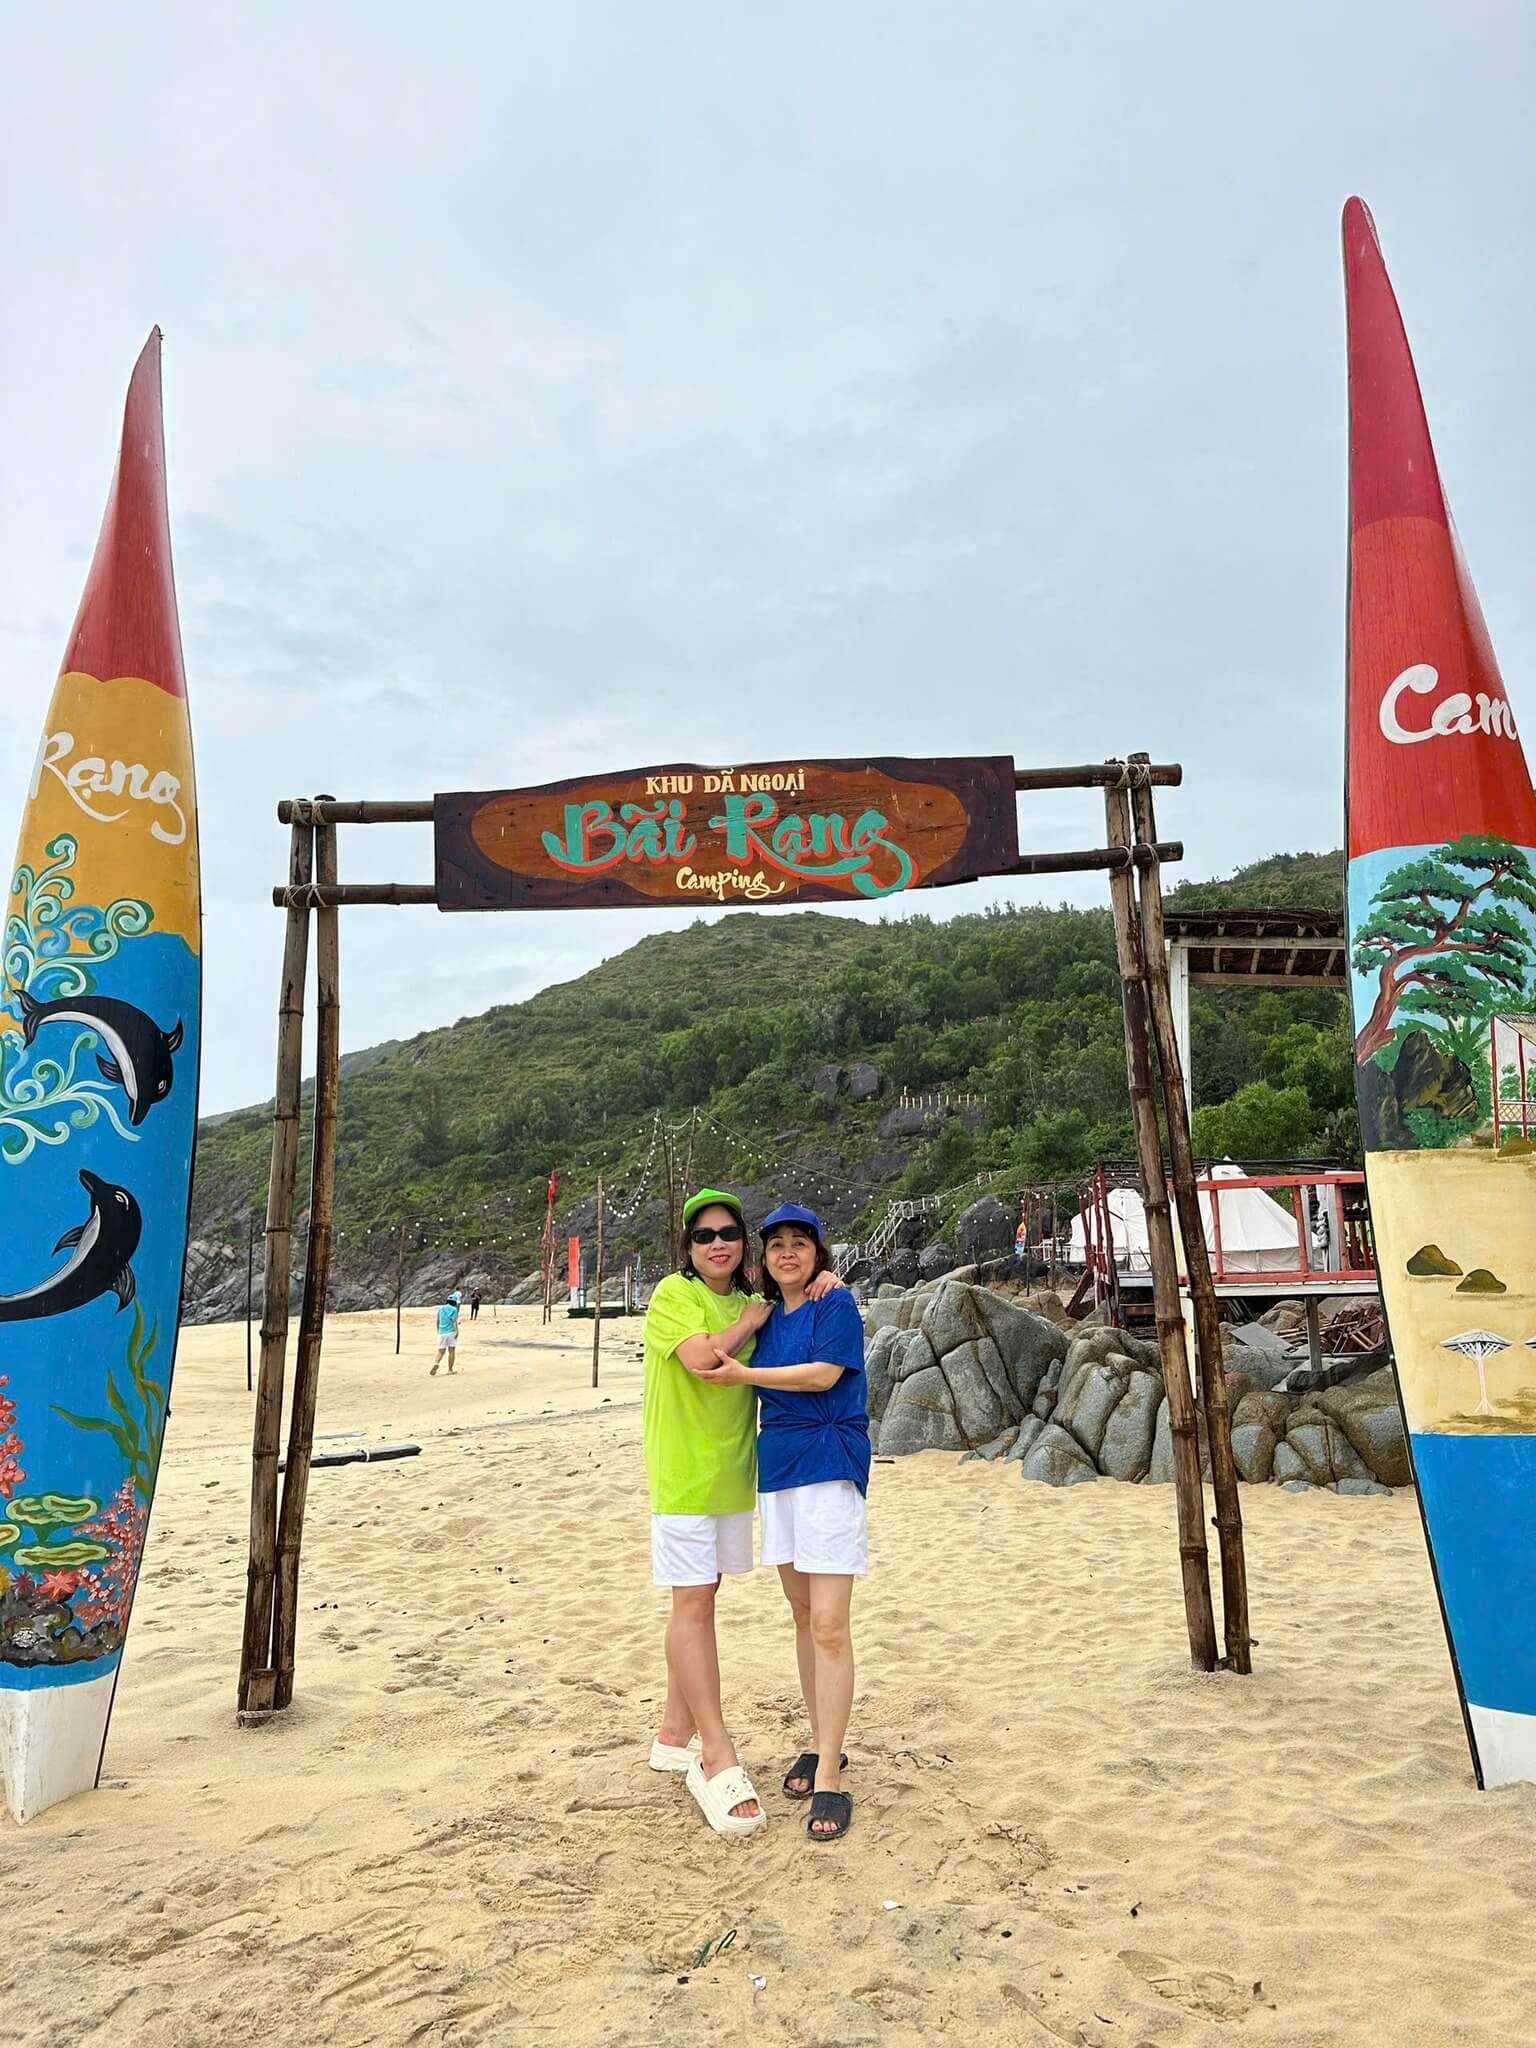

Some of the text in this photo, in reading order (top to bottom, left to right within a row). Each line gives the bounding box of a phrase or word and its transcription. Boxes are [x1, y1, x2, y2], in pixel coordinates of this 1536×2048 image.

[645, 775, 694, 795] KHU
[703, 768, 735, 793] DÃ
[540, 799, 698, 874] Bãi
[676, 866, 786, 901] Camping
